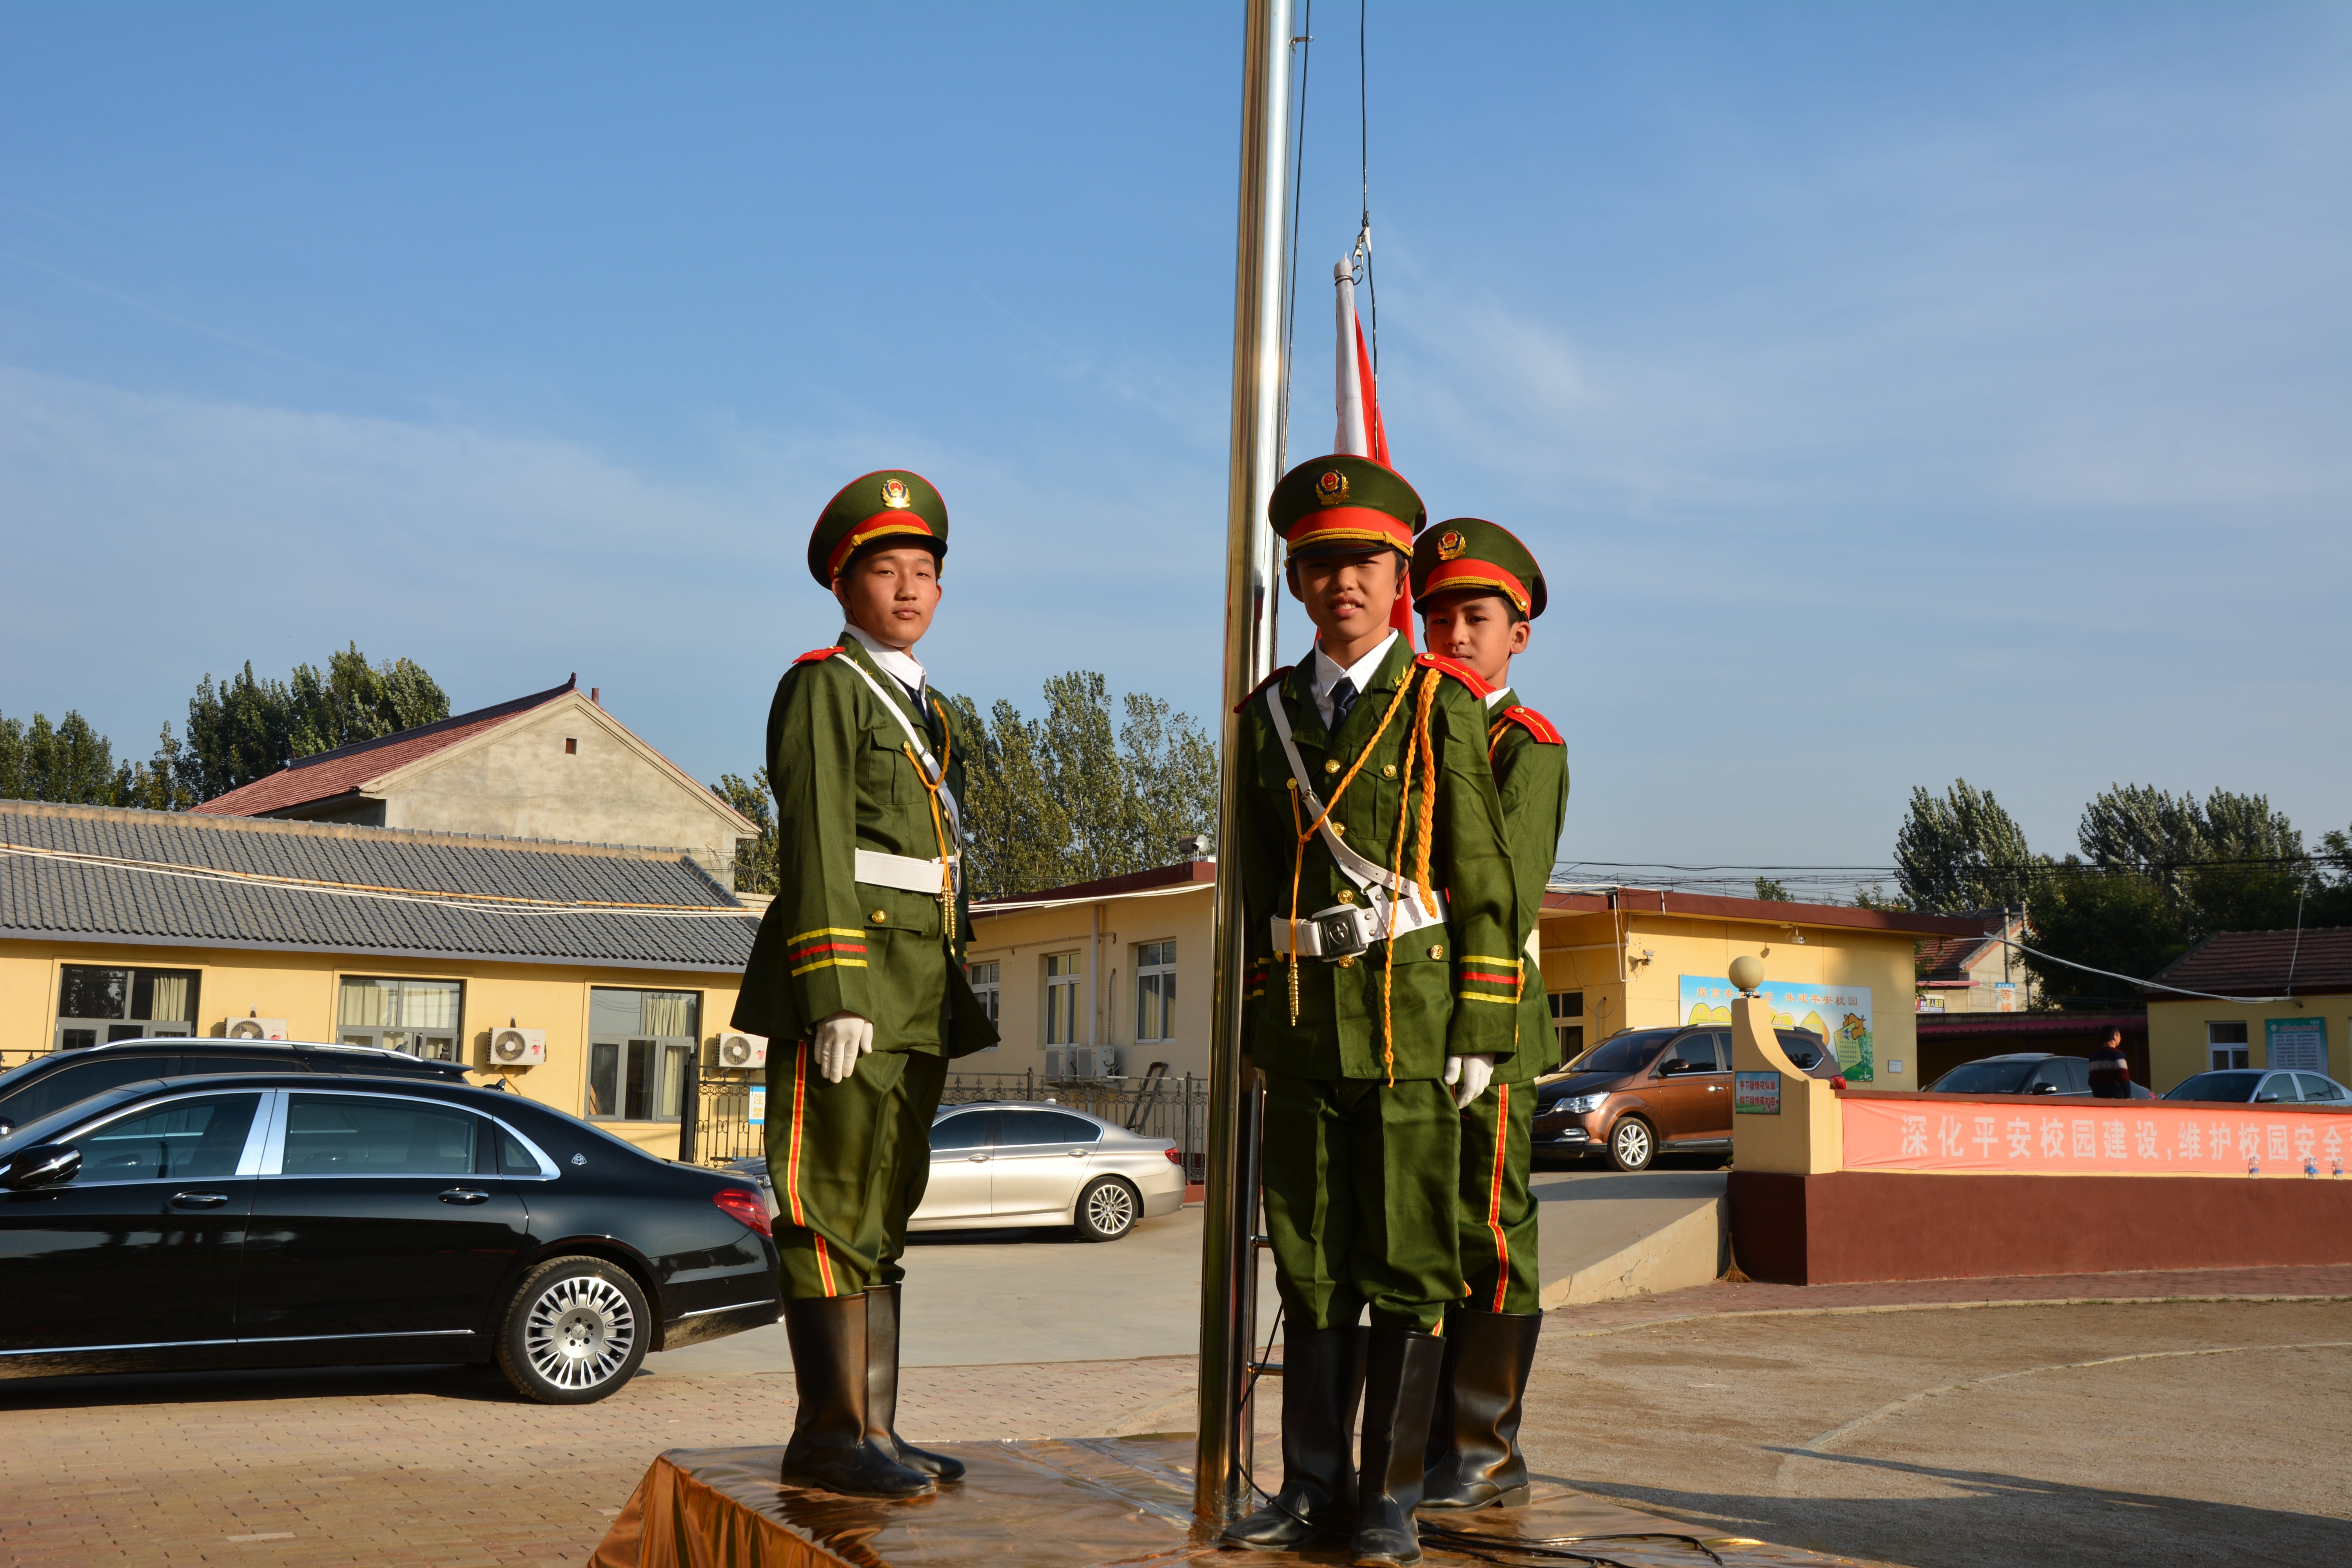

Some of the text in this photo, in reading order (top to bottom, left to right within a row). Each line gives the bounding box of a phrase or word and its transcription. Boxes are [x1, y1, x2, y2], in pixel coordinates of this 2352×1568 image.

[1784, 992, 1857, 1005] 共建平安校园
[1740, 1081, 1775, 1090] 手下留情花似锦
[753, 1094, 763, 1104] 注
[1740, 1096, 1775, 1105] 脚下留情草如茵
[753, 1107, 763, 1118] 禁
[1901, 1115, 2352, 1161] 深化平安校园建设,维护校园安全
